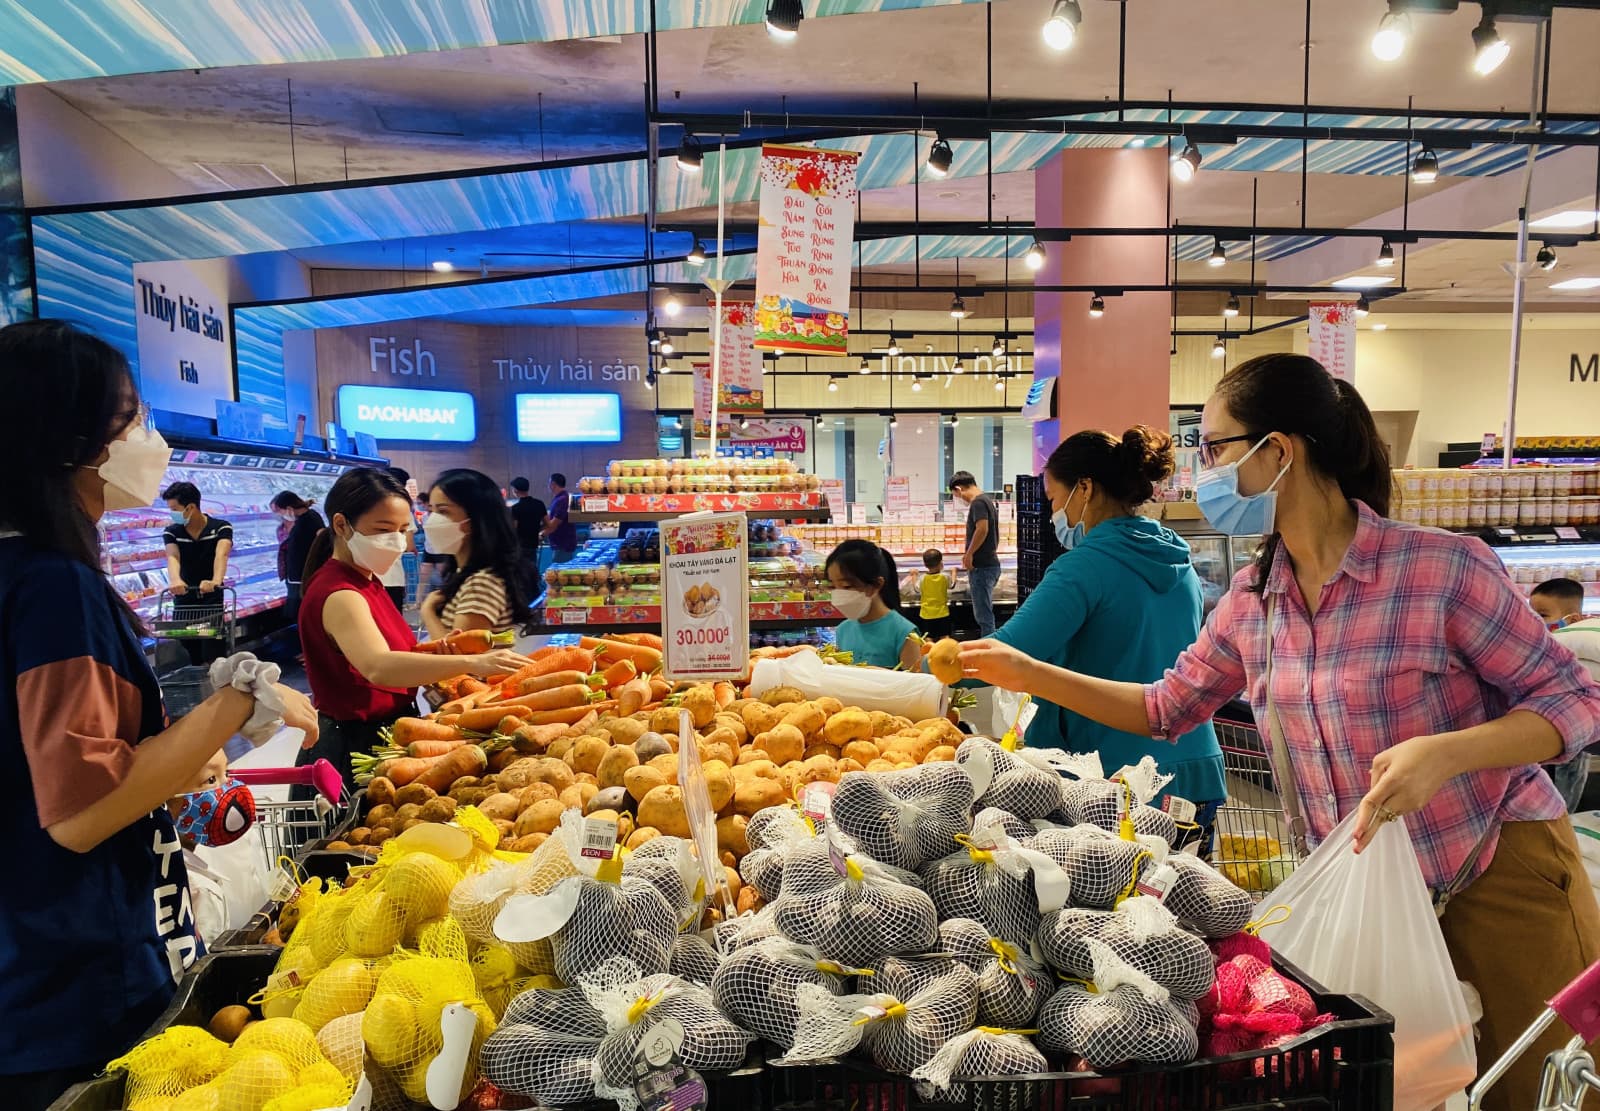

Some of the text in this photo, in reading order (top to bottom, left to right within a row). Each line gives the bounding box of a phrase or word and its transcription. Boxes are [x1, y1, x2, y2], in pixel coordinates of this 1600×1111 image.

[138, 278, 224, 342] Thủy hải sản
[369, 337, 436, 376] Fish
[1569, 353, 1599, 382] M
[179, 360, 199, 384] Fish
[492, 357, 641, 385] Thủy hải sản
[654, 1064, 685, 1085] Purple
